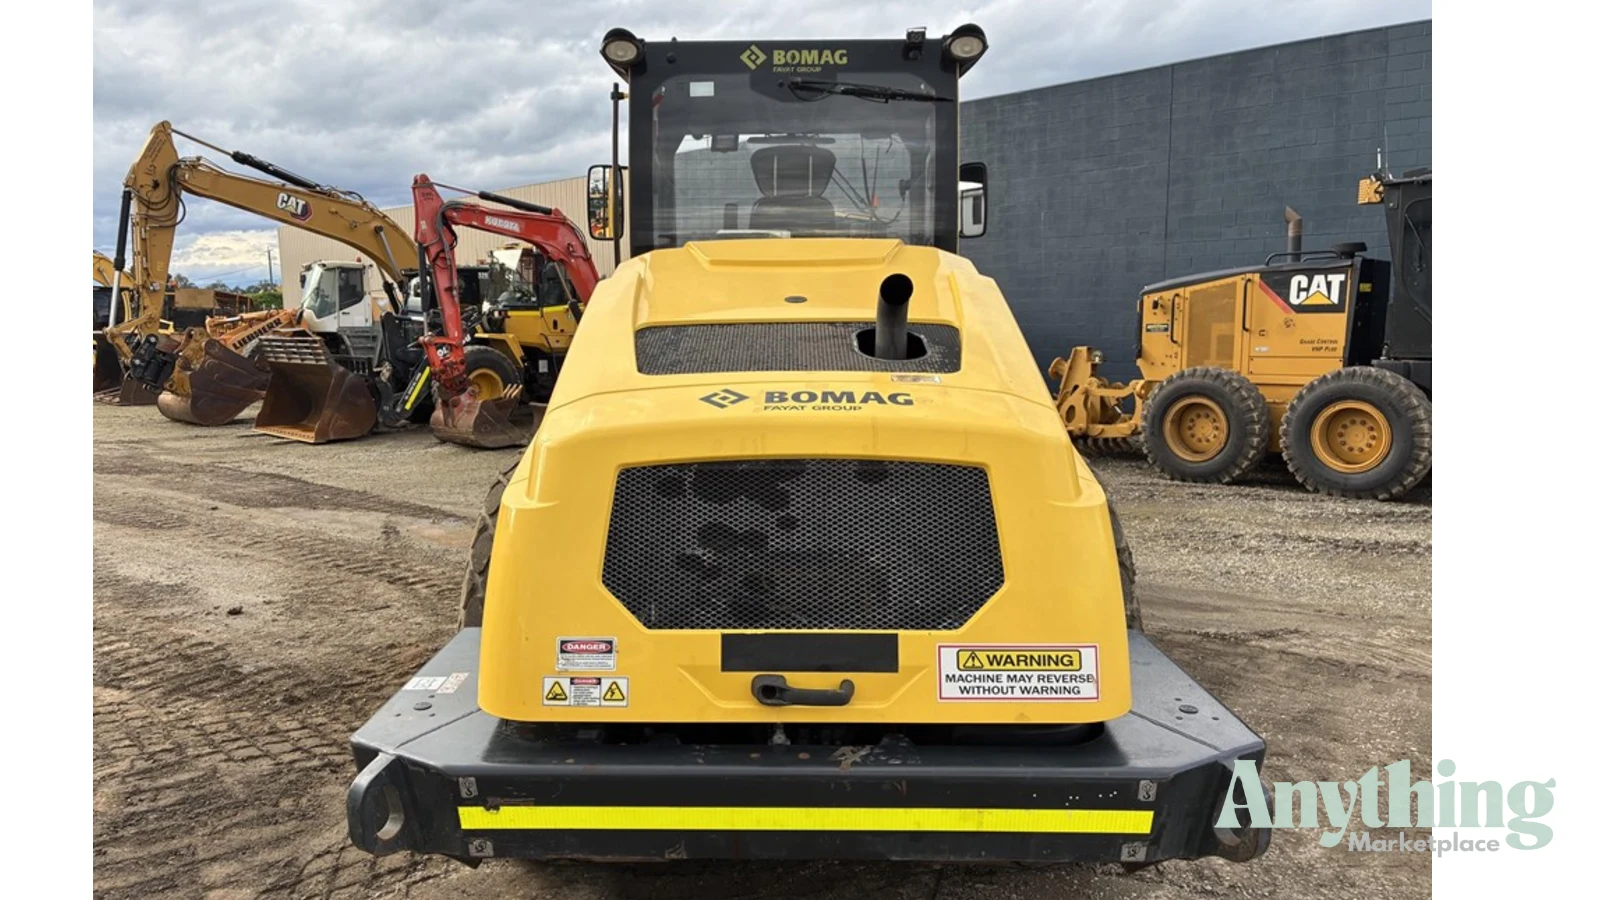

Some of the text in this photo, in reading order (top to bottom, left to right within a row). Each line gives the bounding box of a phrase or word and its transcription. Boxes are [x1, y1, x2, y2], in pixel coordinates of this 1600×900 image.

[773, 49, 848, 65] BOMAG
[277, 193, 306, 216] CAT
[1289, 274, 1346, 305] CAT
[232, 317, 282, 350] LIEBHERR
[764, 391, 914, 406] BOMAG
[986, 654, 1074, 667] WARNING
[945, 674, 1095, 683] MACHINE MAY REVERSE
[958, 685, 1081, 695] WITHOUT WARNING
